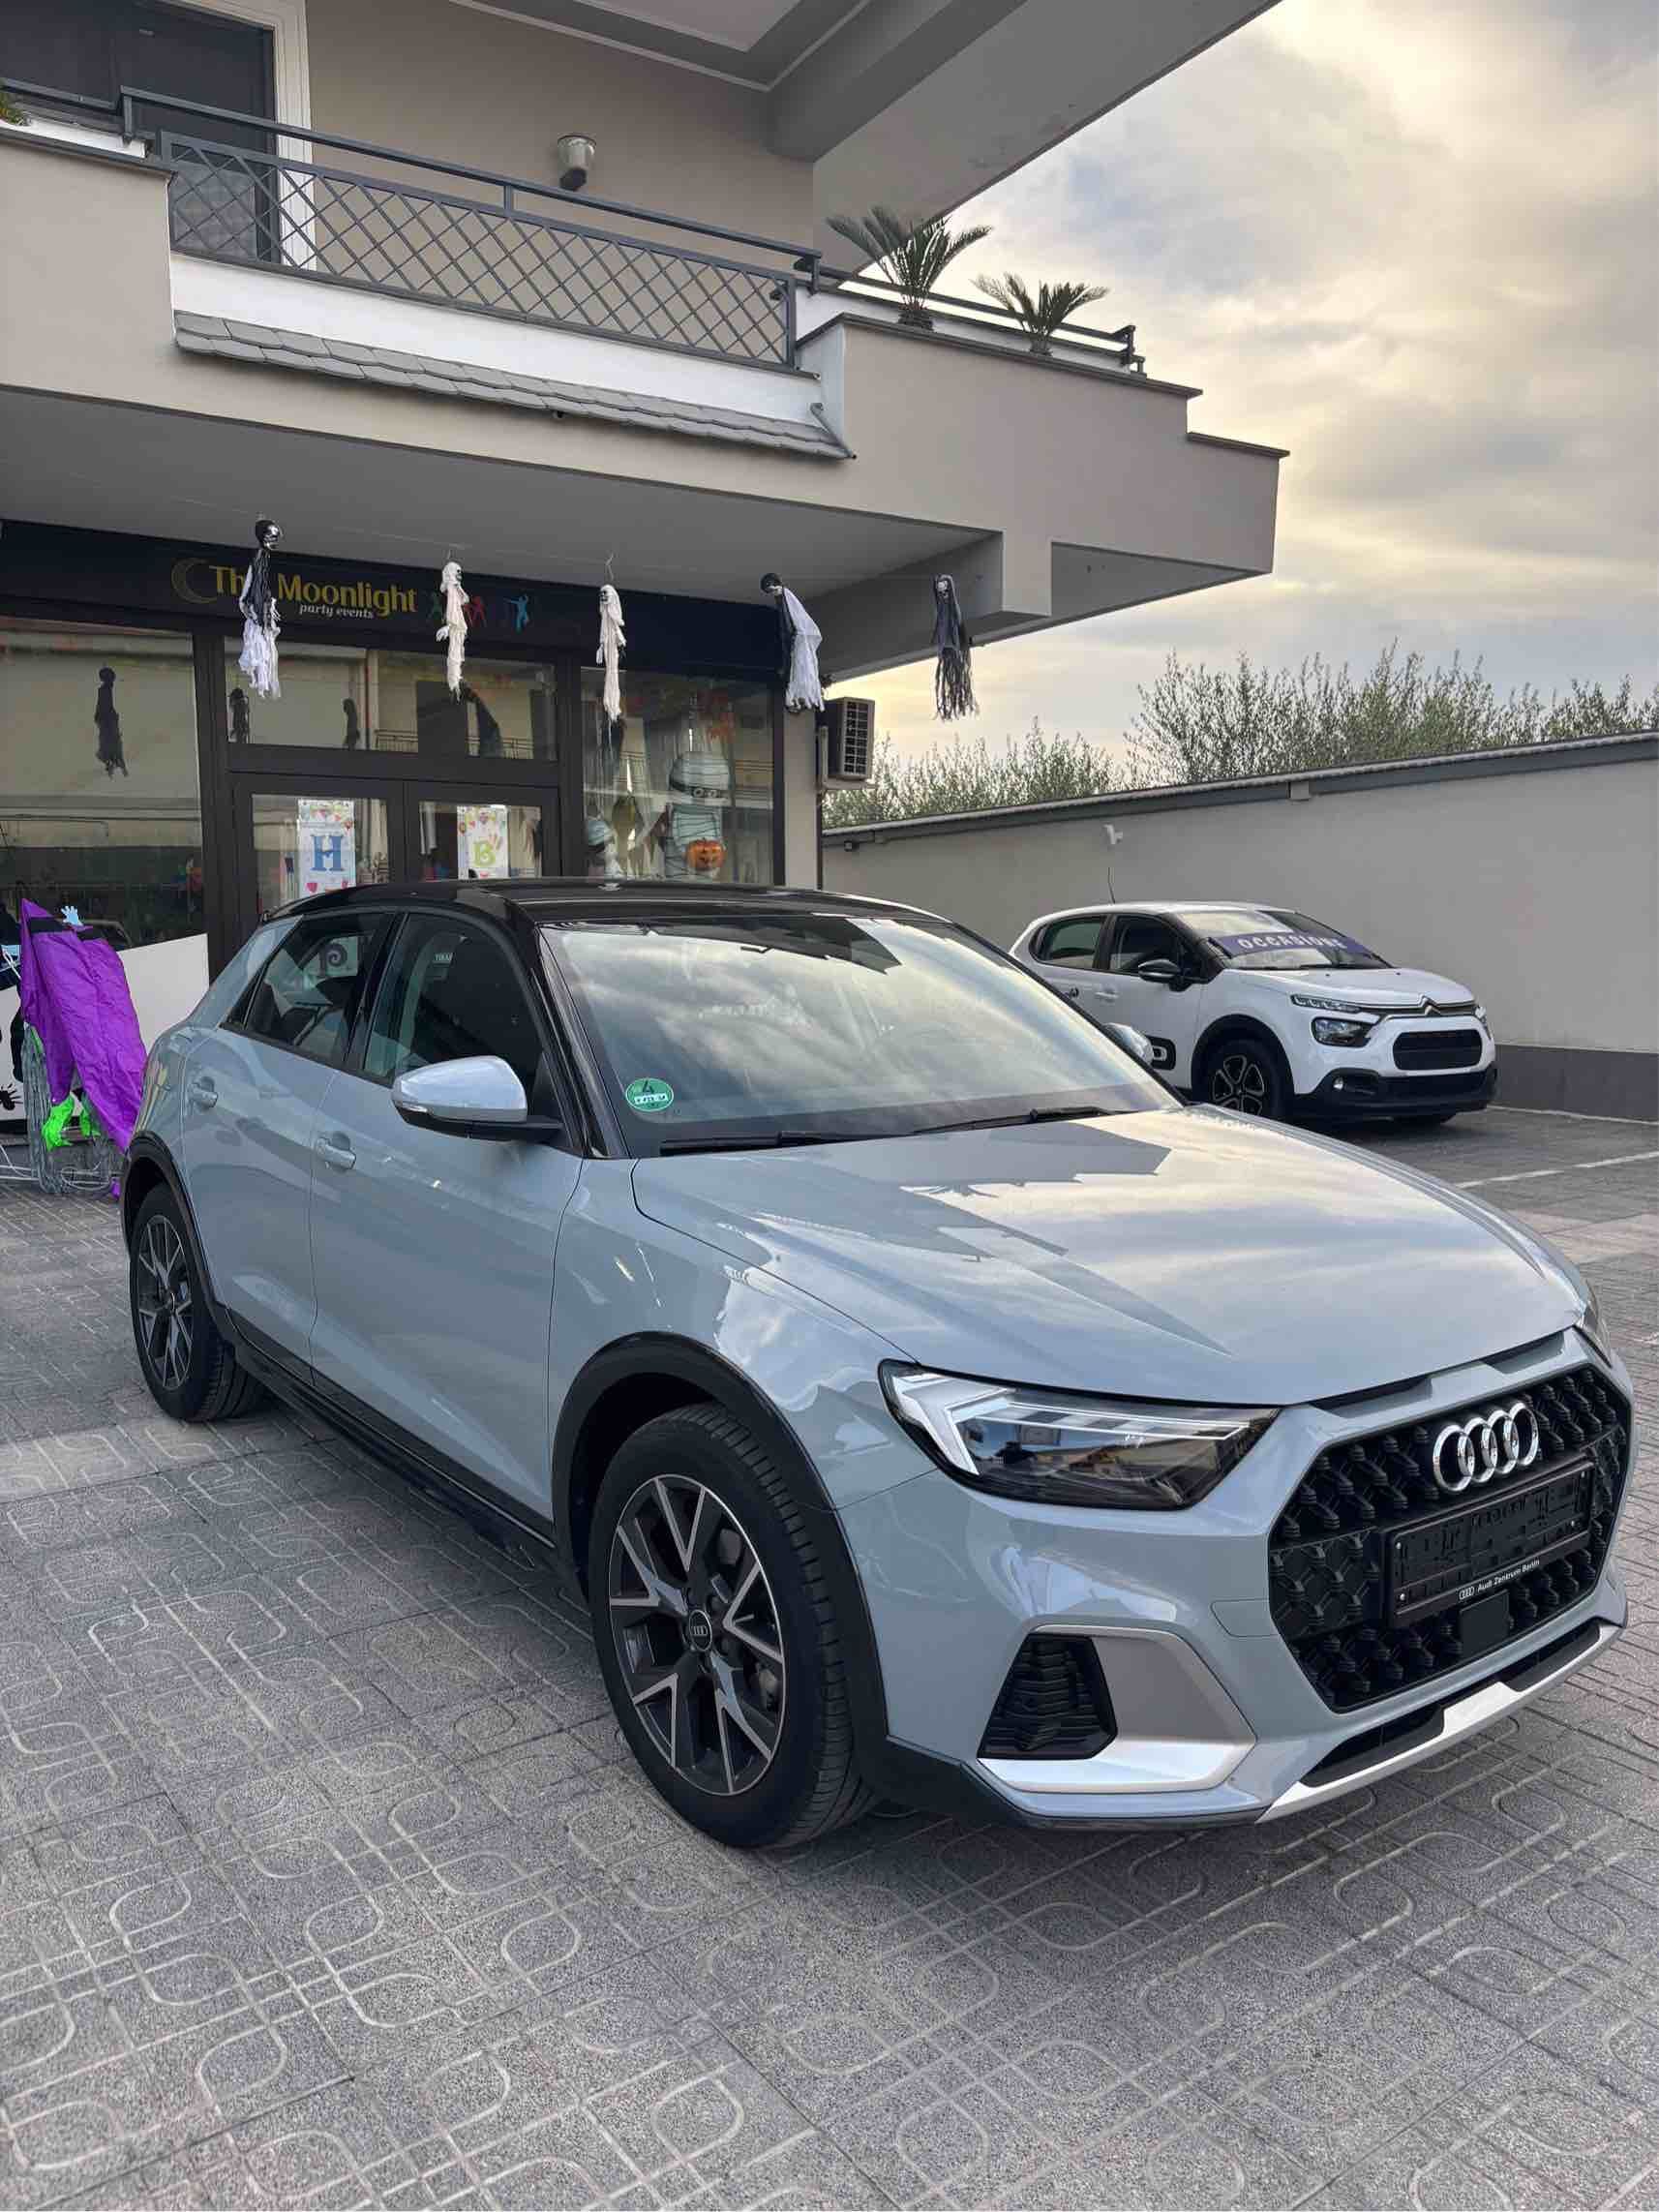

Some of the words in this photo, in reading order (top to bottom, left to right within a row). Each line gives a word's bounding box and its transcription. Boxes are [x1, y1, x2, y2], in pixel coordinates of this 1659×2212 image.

[210, 565, 246, 595] Th
[278, 573, 417, 617] Moonlight
[299, 602, 334, 618] party
[336, 606, 375, 621] events
[310, 833, 346, 872] H
[1237, 935, 1348, 950] OCCASIONE
[1477, 1579, 1493, 1592] Audi
[1493, 1567, 1522, 1585] Zentrum
[1522, 1558, 1540, 1572] Berlin
